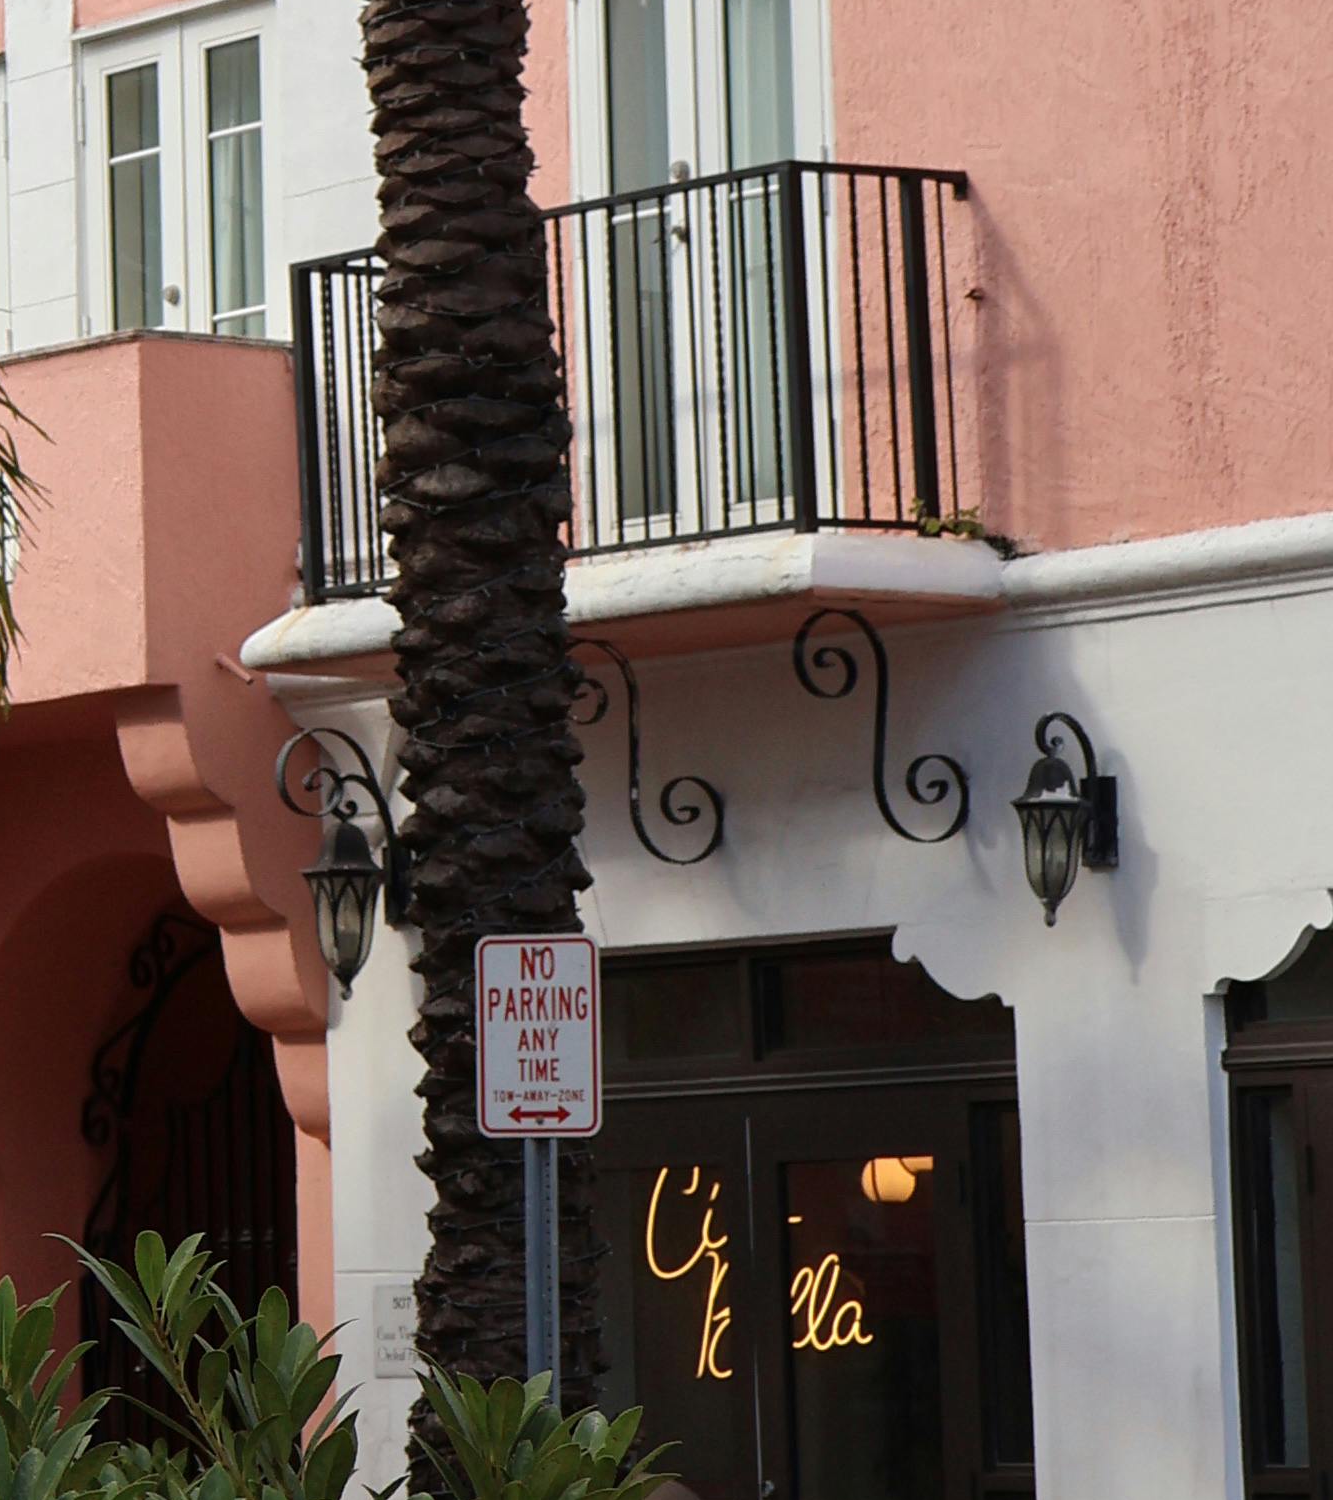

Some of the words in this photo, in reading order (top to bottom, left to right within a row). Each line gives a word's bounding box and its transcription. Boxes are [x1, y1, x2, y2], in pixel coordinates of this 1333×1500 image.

[519, 946, 556, 981] NO
[488, 986, 589, 1022] PARKING
[517, 1028, 560, 1052] ANY
[517, 1058, 561, 1082] TIME
